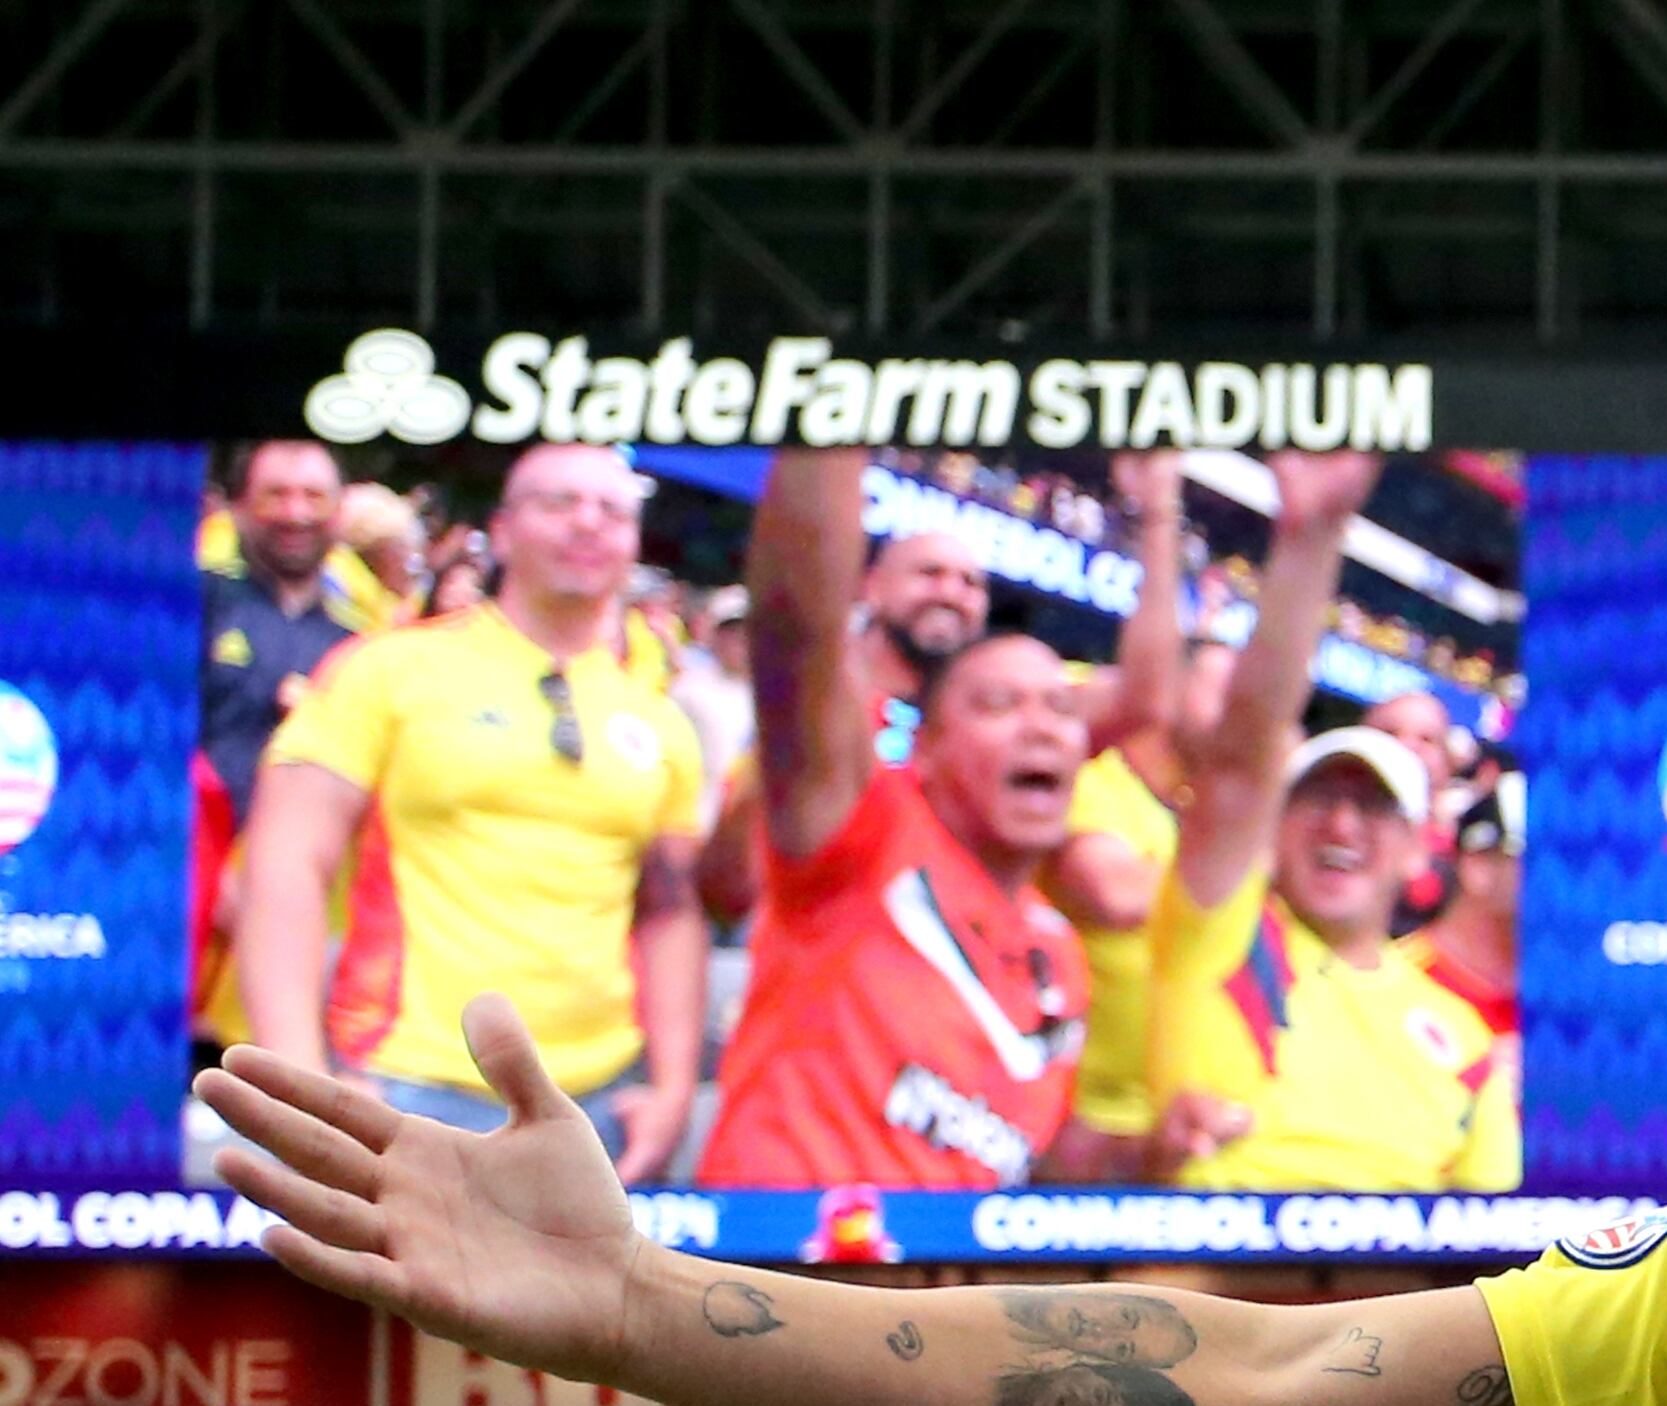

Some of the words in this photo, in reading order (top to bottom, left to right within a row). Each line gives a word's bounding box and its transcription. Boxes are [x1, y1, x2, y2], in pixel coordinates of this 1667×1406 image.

[1028, 358, 1433, 453] STADIUM
[72, 1190, 225, 1249] COPA
[1276, 1193, 1427, 1252] COPA
